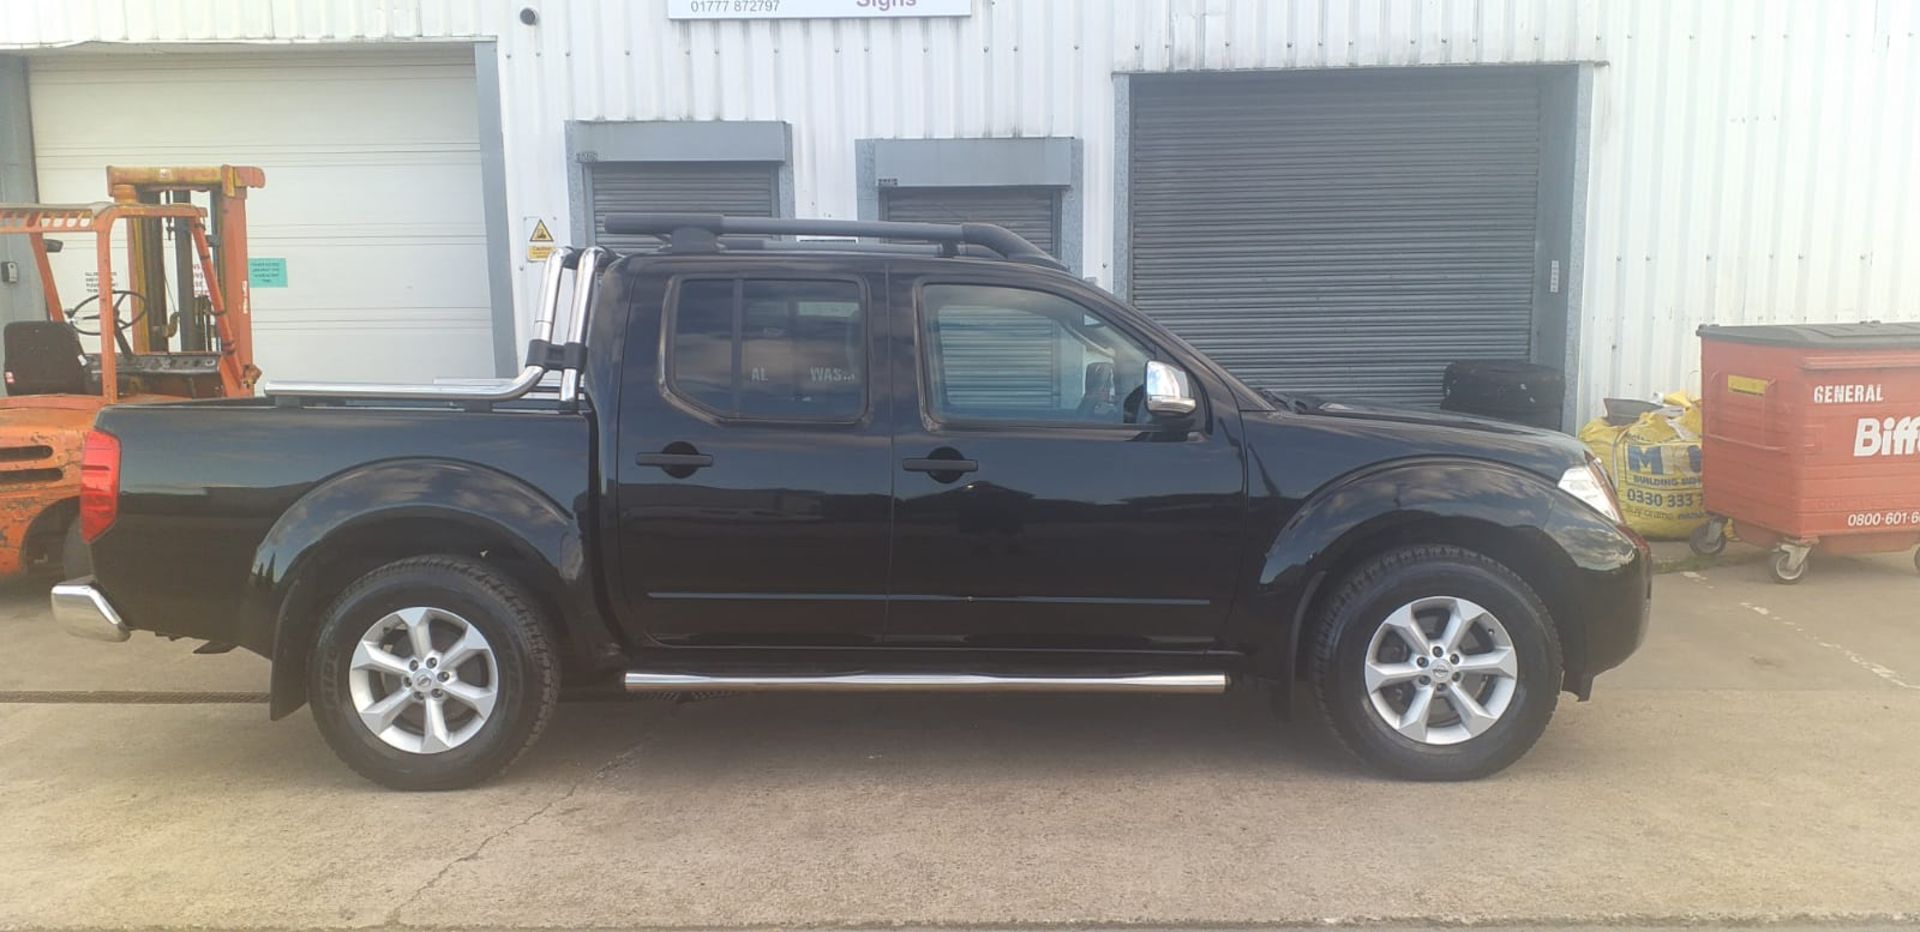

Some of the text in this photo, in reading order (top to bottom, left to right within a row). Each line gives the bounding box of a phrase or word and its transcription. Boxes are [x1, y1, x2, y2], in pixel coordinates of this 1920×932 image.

[690, 1, 780, 13] 01777 872797
[1813, 384, 1884, 404] GENERAL
[1853, 415, 1920, 457] Biff
[1627, 488, 1663, 507] 0330
[1667, 494, 1694, 508] 333
